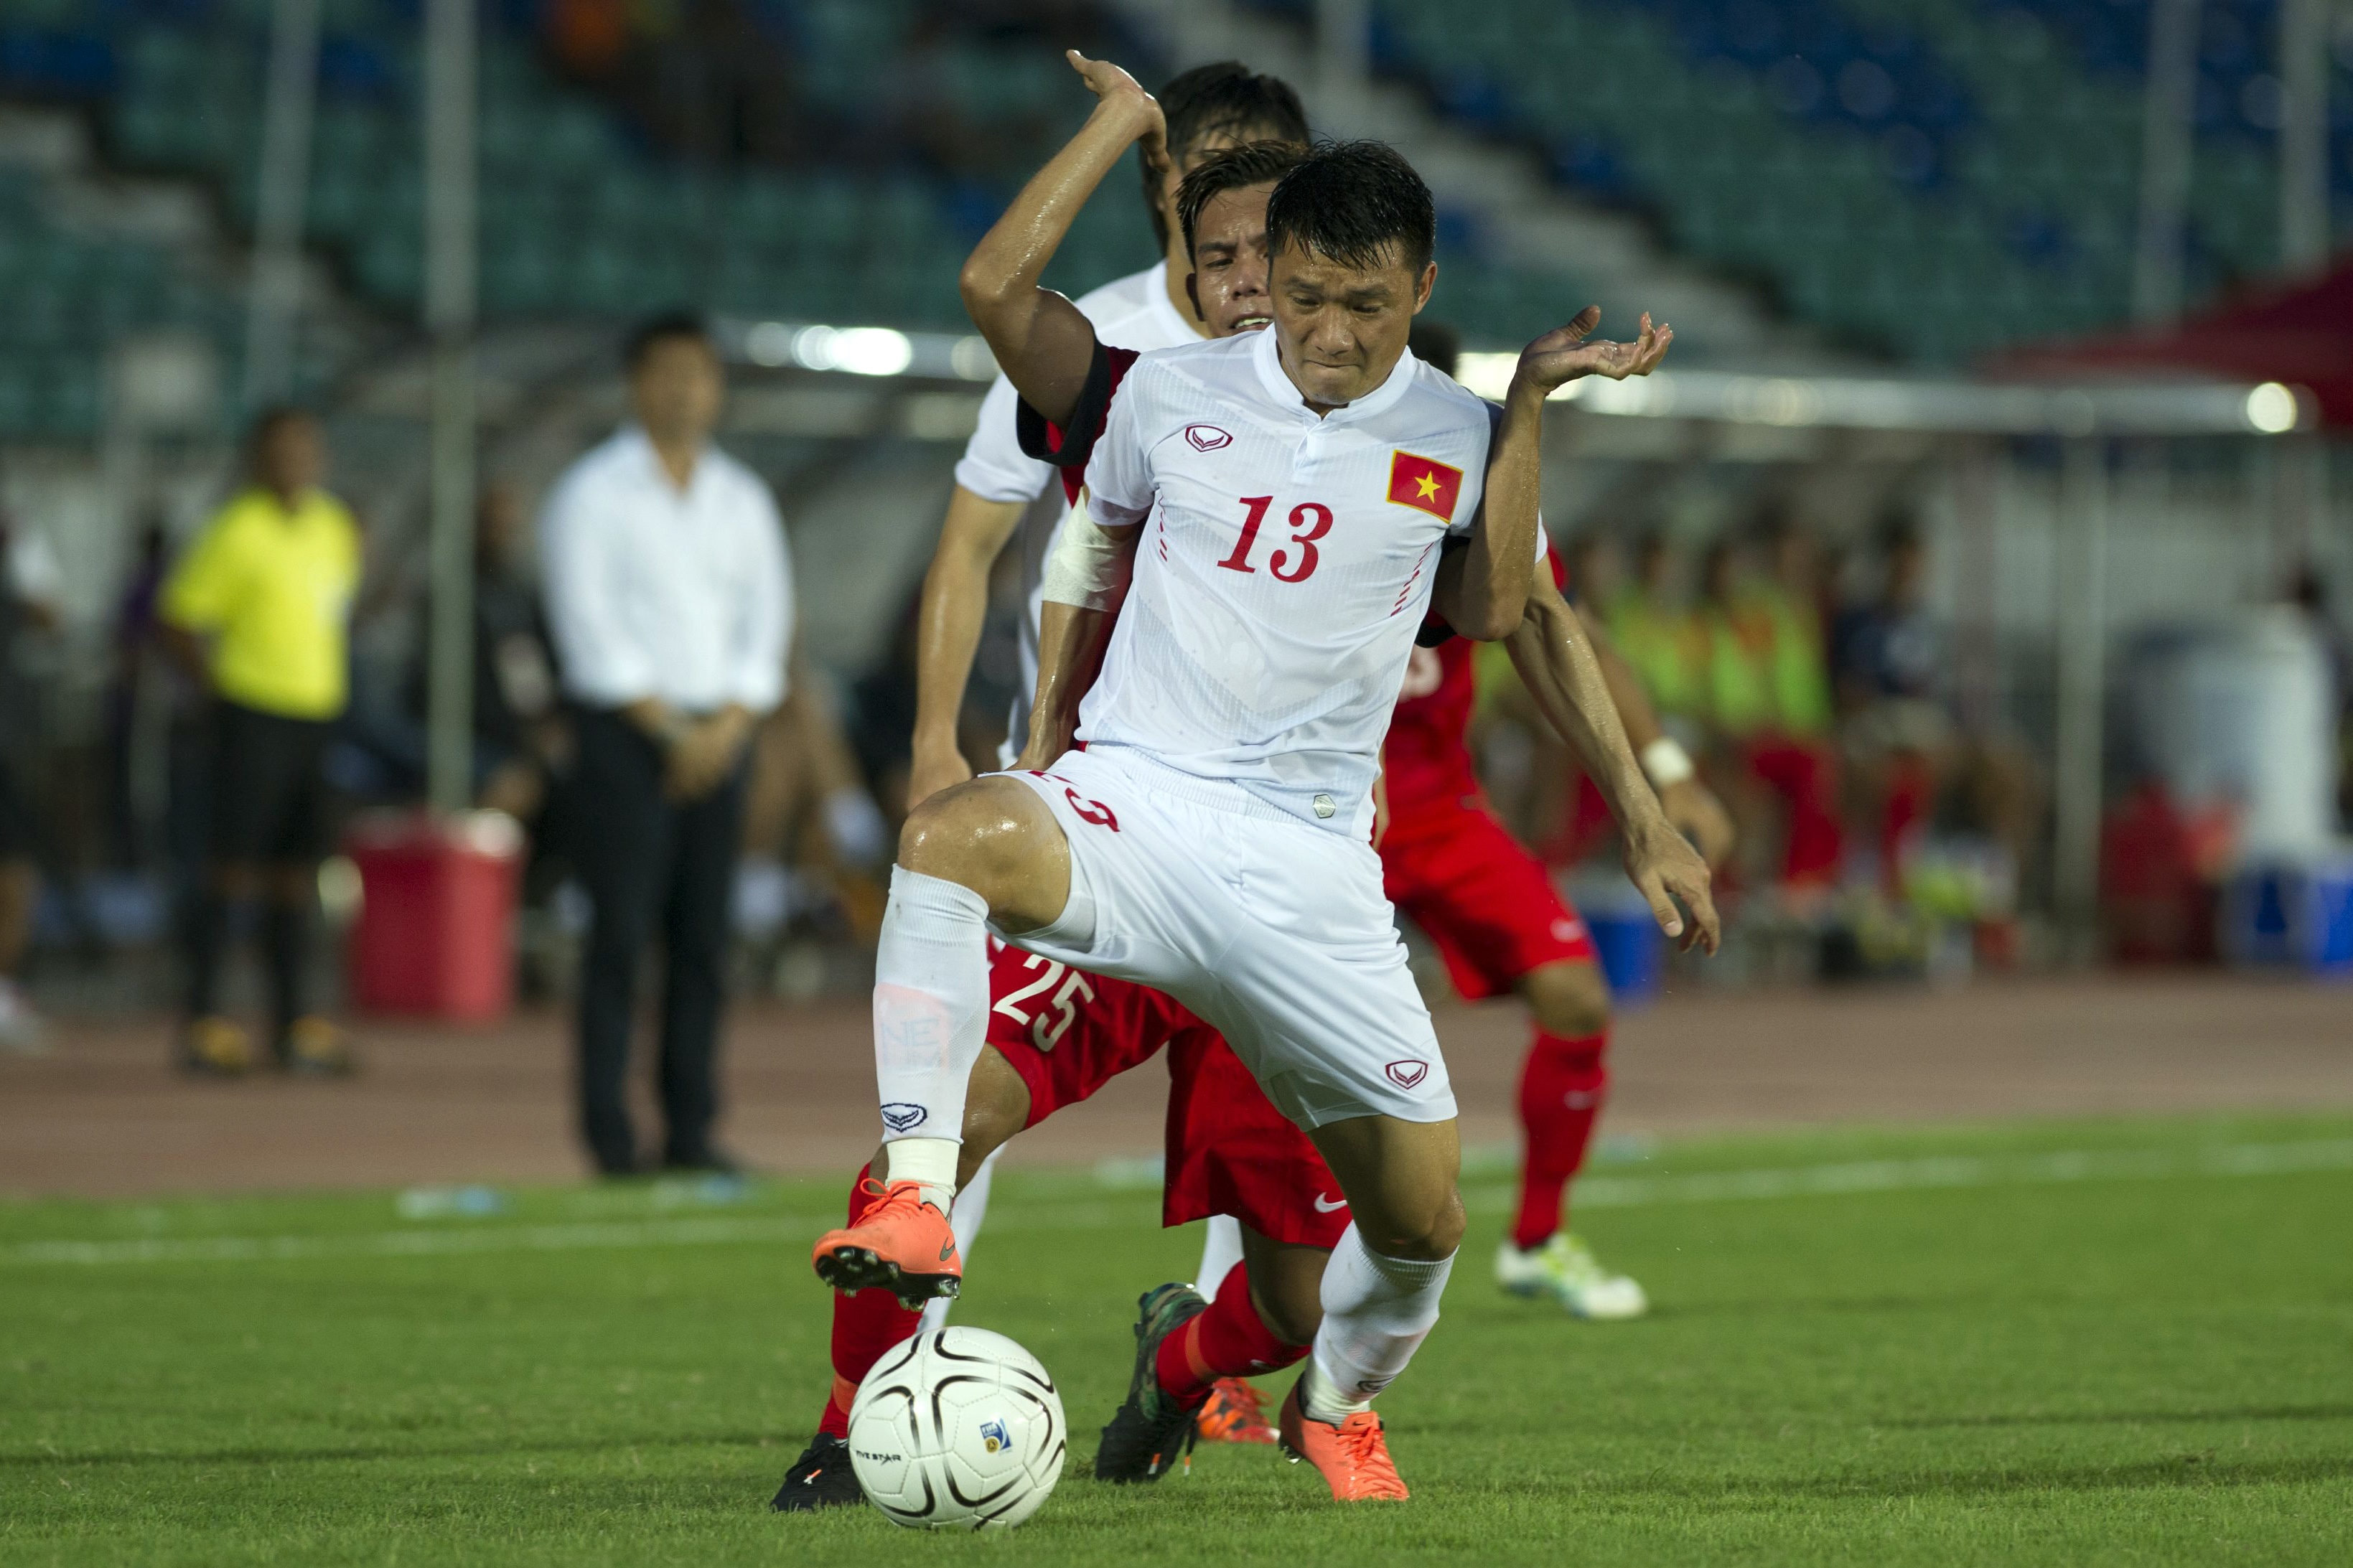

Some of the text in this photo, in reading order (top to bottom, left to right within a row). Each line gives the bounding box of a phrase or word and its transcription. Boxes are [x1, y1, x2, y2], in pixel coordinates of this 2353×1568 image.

[1217, 495, 1334, 583] 13
[992, 954, 1095, 1052] 25
[872, 1453, 902, 1465] STAR
